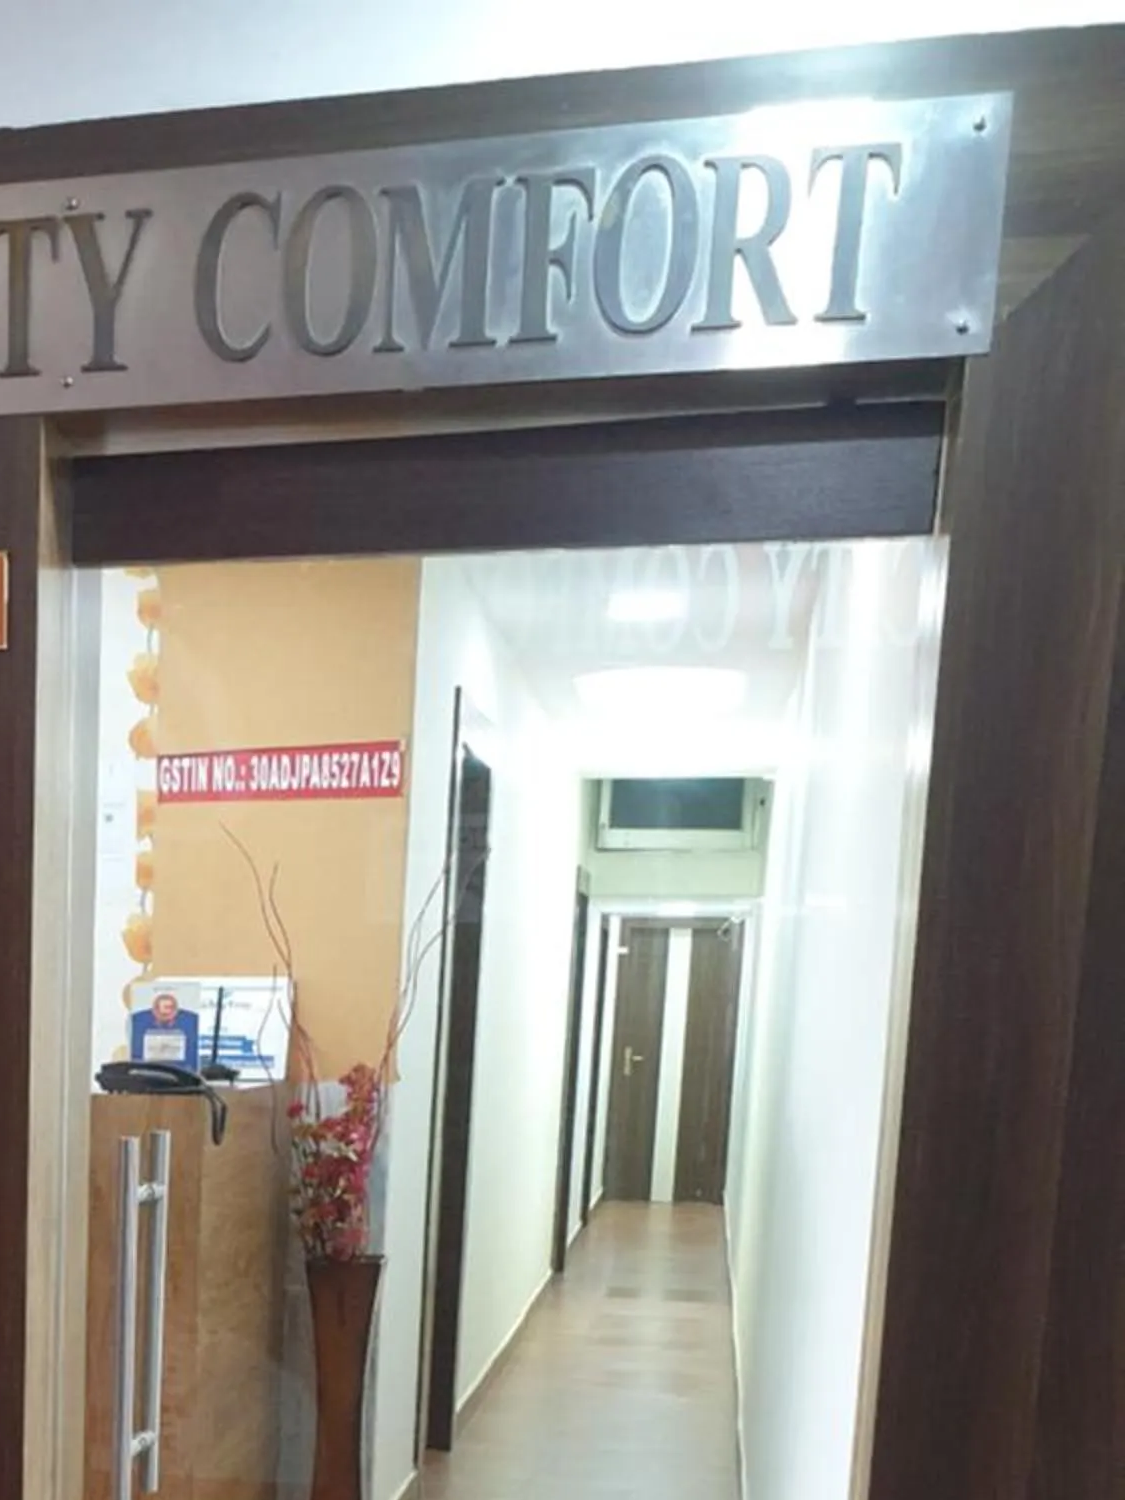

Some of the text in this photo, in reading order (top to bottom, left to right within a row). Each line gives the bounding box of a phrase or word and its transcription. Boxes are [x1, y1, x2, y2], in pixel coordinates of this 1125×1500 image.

[193, 143, 904, 363] COMFORT
[160, 757, 209, 793] GSTIN
[212, 754, 246, 792] NO.:
